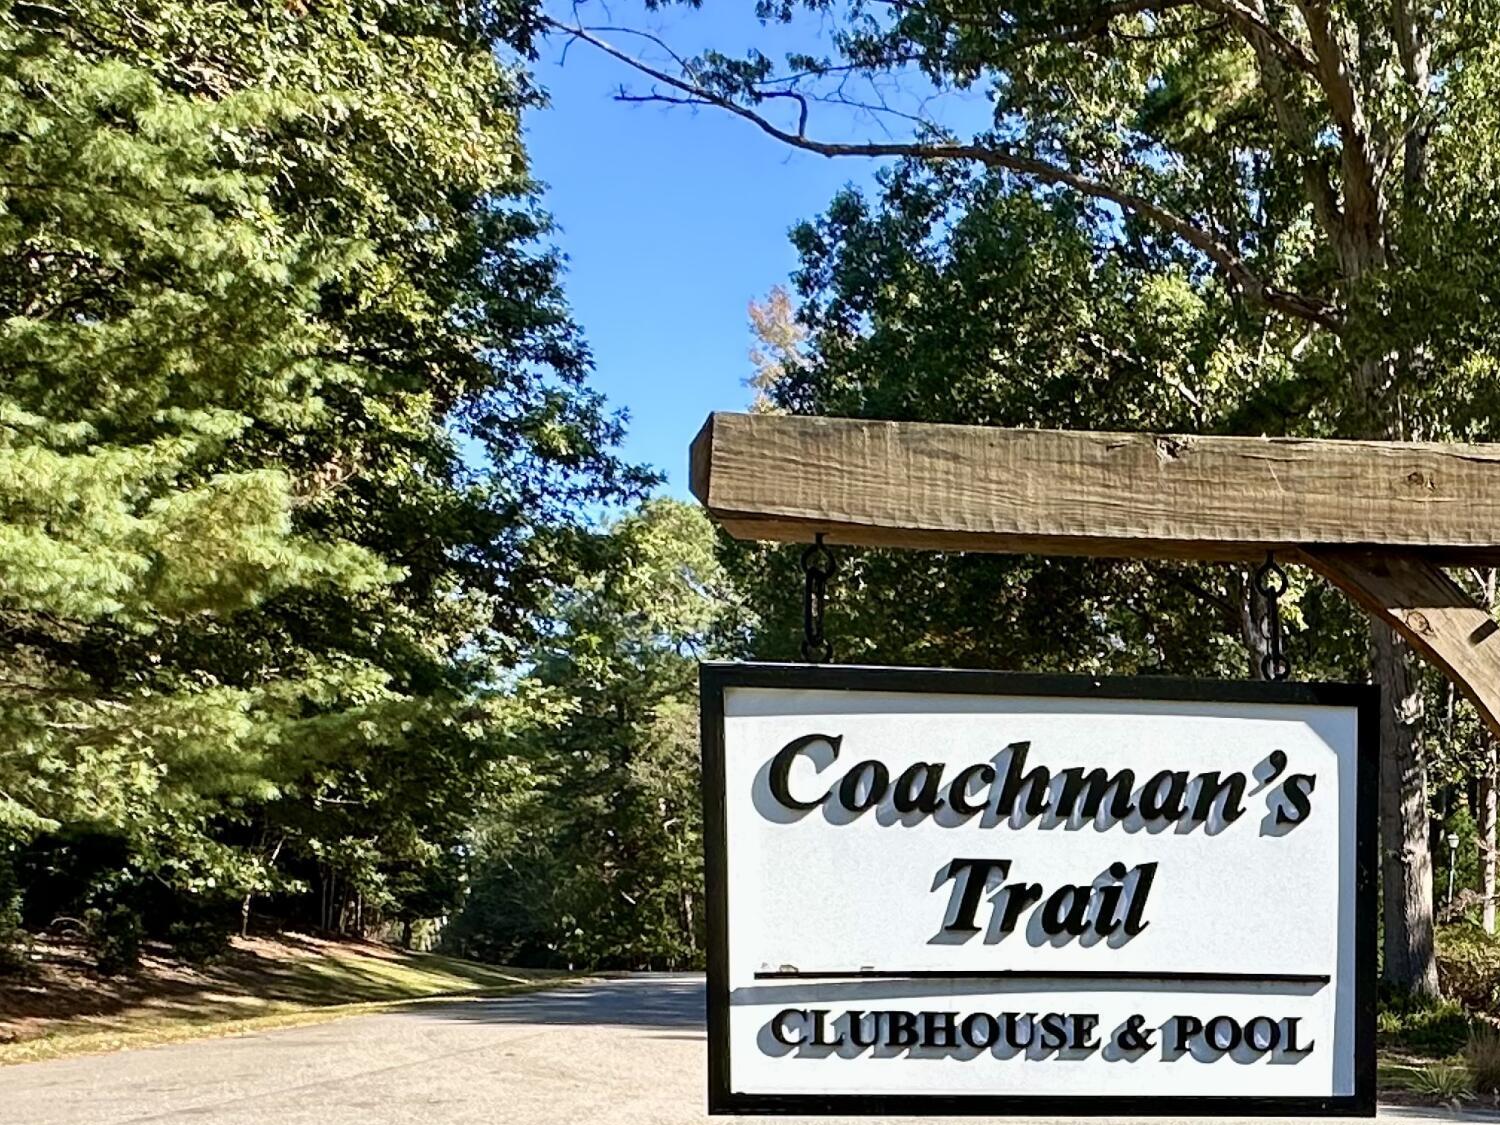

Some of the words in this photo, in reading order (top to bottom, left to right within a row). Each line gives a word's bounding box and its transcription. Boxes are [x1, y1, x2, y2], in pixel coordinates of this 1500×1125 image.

[767, 733, 1317, 829] Coachman's
[942, 857, 1158, 940] Trail
[770, 1008, 1102, 1055] CLUBHOUSE
[1116, 1014, 1157, 1055] &
[1171, 1015, 1316, 1057] POOL
